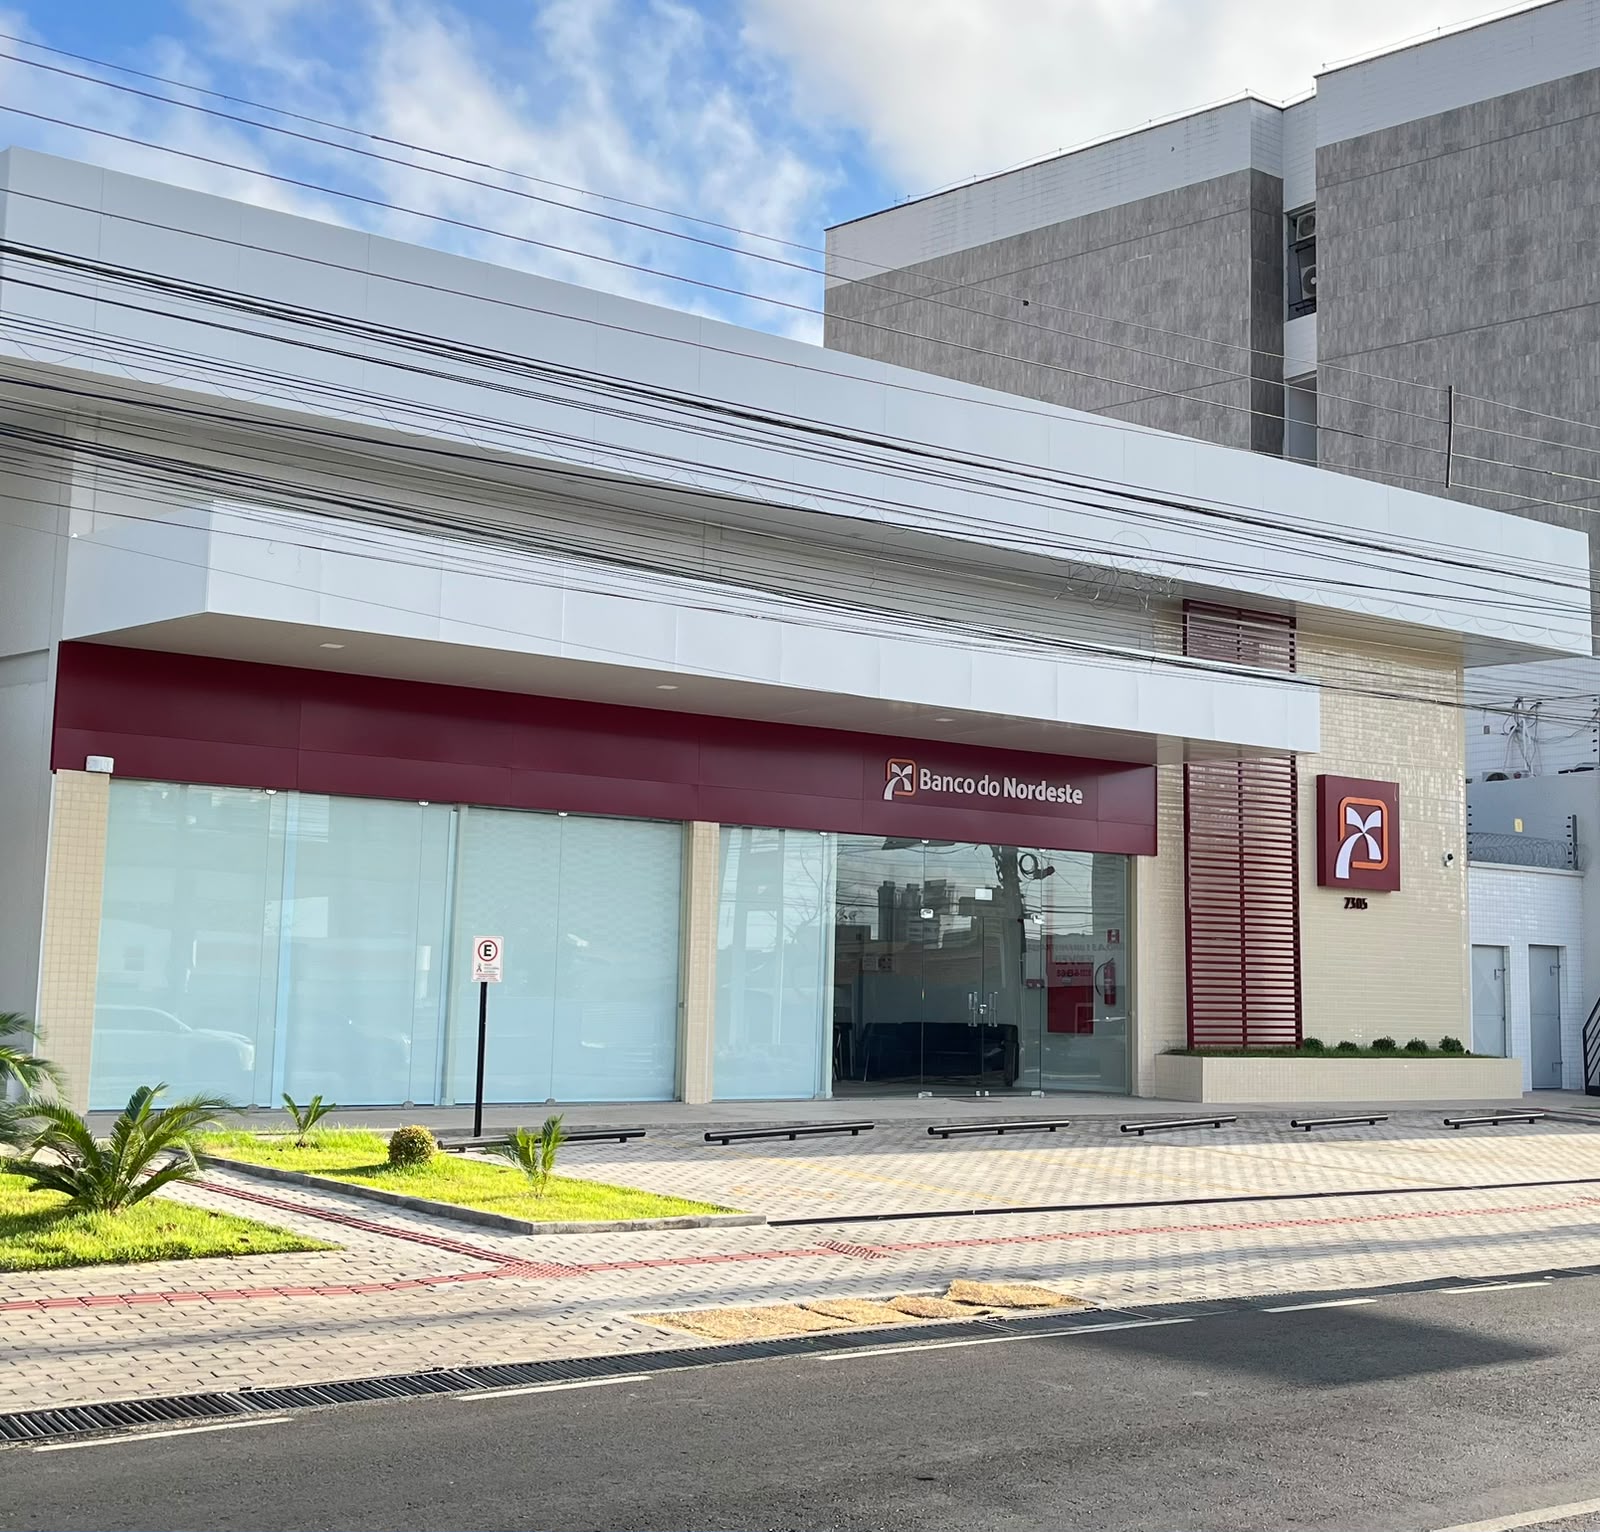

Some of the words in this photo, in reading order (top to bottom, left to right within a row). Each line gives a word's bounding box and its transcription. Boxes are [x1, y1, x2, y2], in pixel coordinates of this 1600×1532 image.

[919, 768, 976, 794] Banco
[977, 775, 1000, 796] do
[1003, 776, 1084, 804] Nordeste
[483, 944, 492, 957] E
